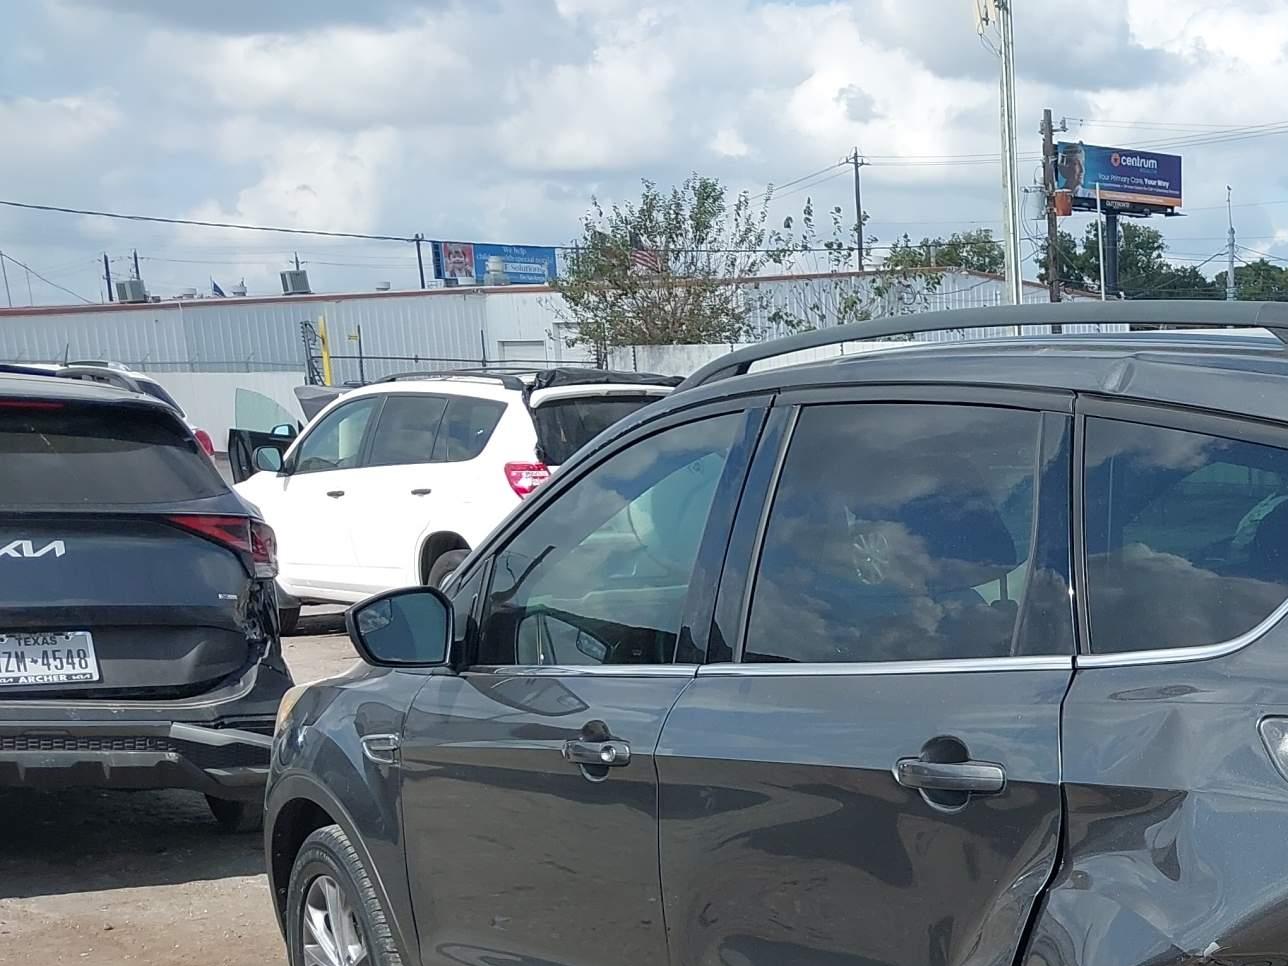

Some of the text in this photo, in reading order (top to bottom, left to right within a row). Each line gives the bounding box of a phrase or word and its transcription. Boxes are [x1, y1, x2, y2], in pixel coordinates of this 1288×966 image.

[1121, 156, 1157, 168] centrum
[1110, 174, 1130, 184] Primary
[1144, 178, 1157, 186] Your
[1157, 179, 1170, 189] Way
[15, 635, 58, 647] TEXAS
[41, 648, 89, 671] 4548
[18, 673, 67, 684] ARCHER
